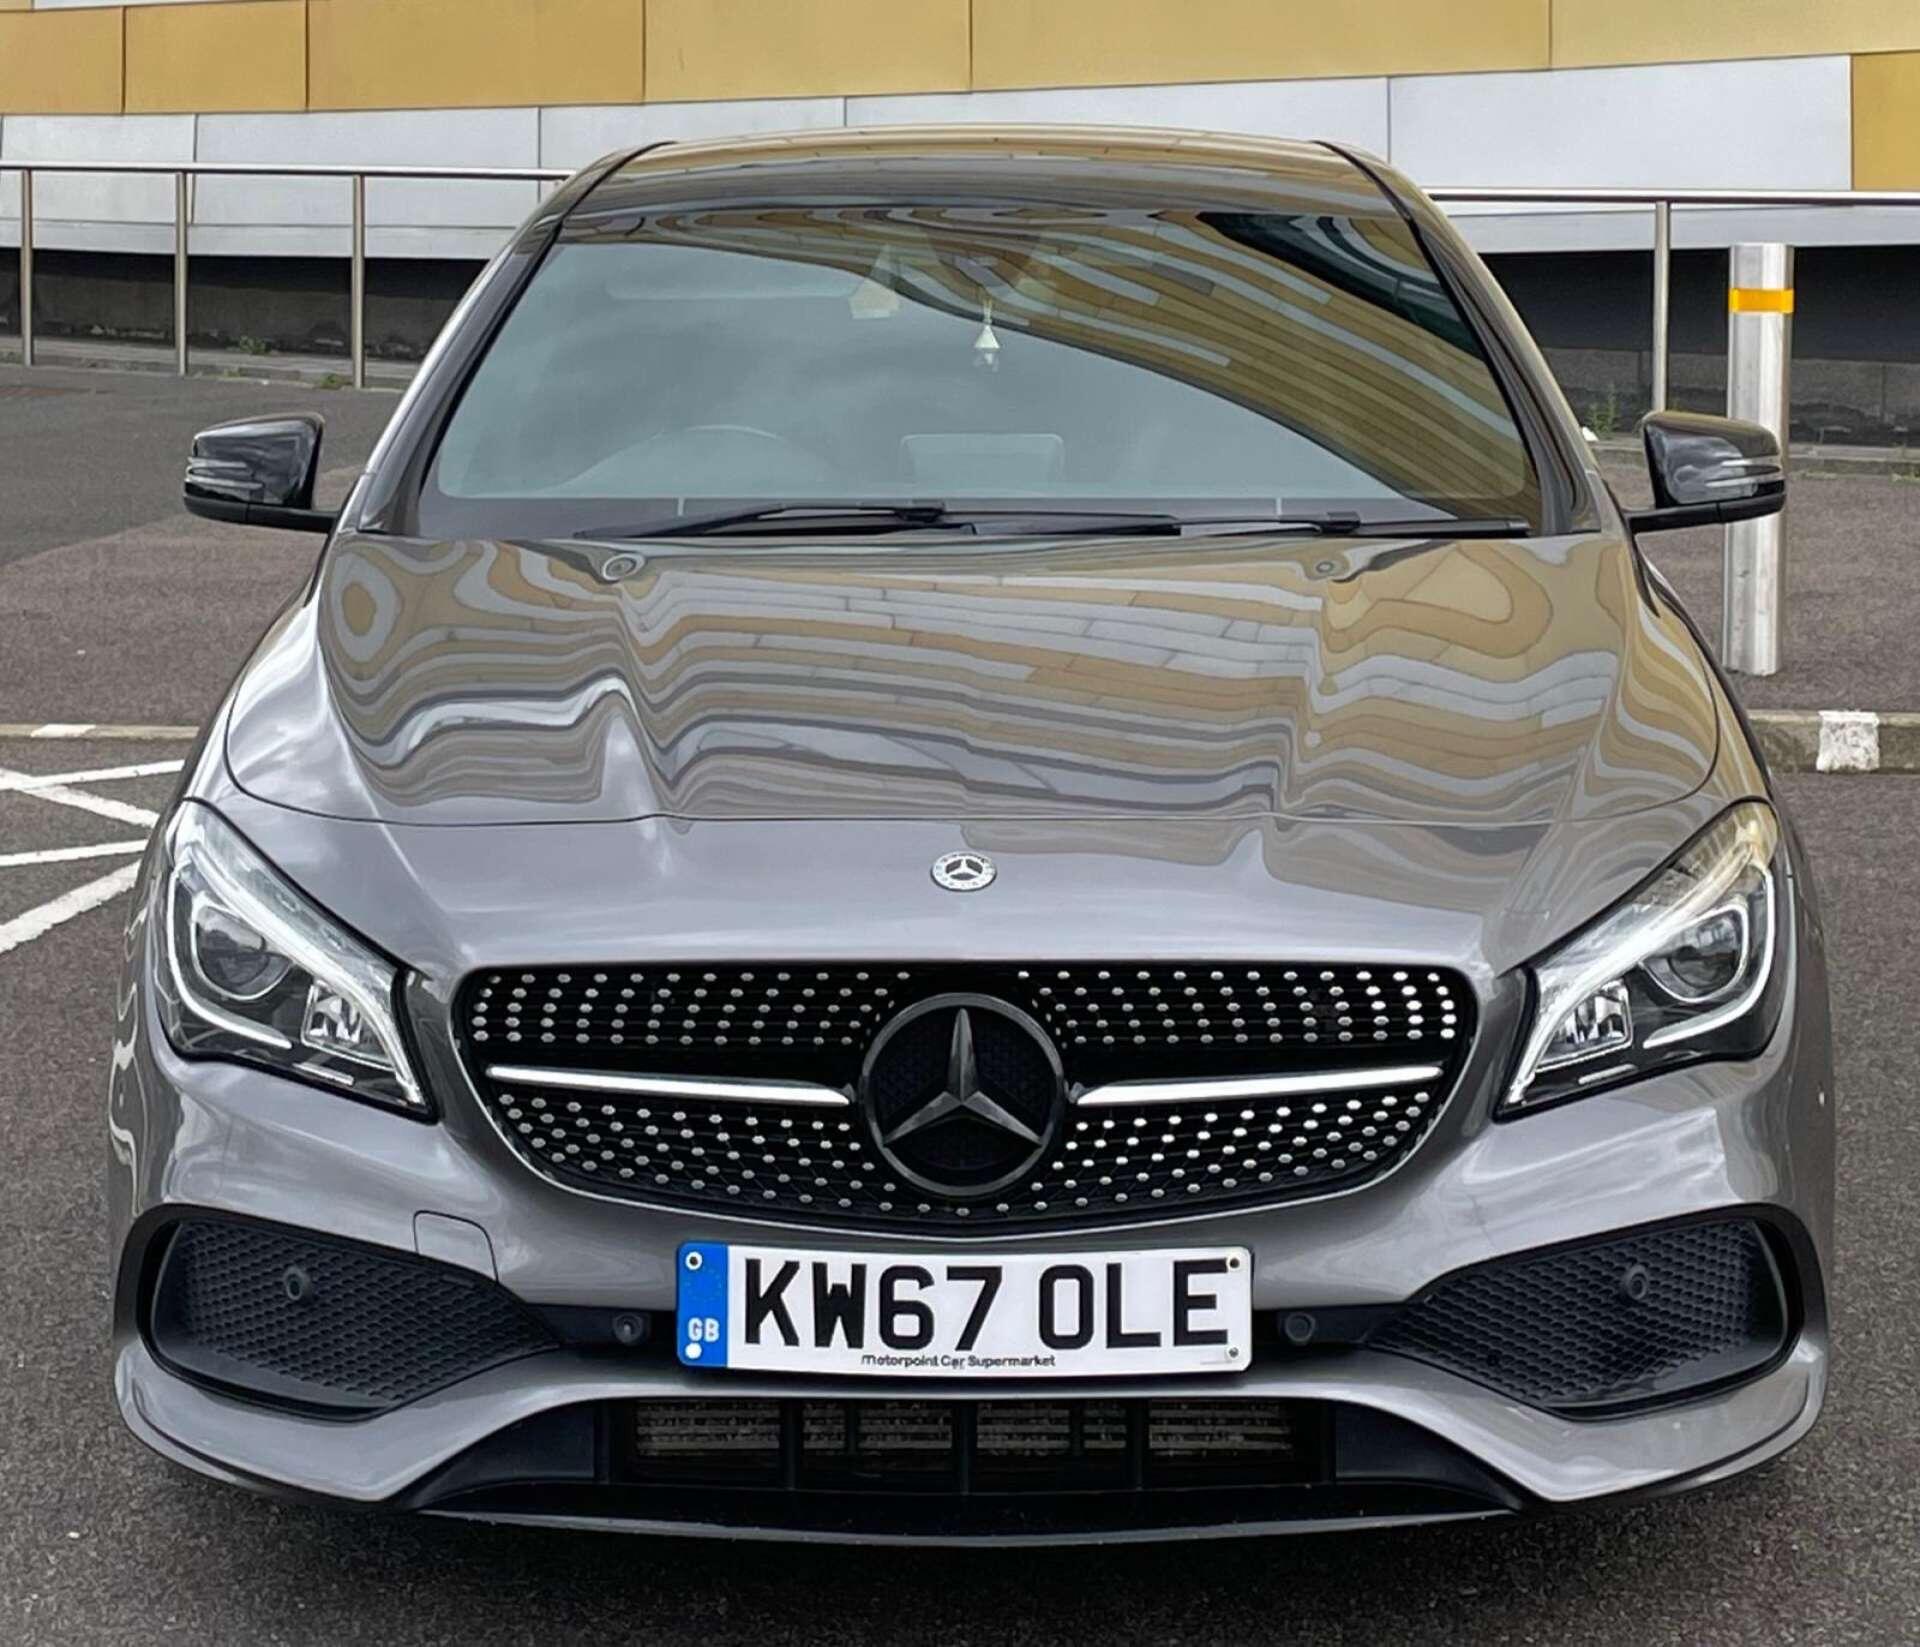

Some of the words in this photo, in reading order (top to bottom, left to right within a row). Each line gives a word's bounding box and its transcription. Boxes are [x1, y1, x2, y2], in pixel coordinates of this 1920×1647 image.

[744, 1258, 1003, 1352] KW67
[1037, 1259, 1229, 1350] OLE
[688, 1317, 720, 1342] GB
[861, 1354, 939, 1368] Motorpoint
[967, 1354, 1056, 1368] Supermarket
